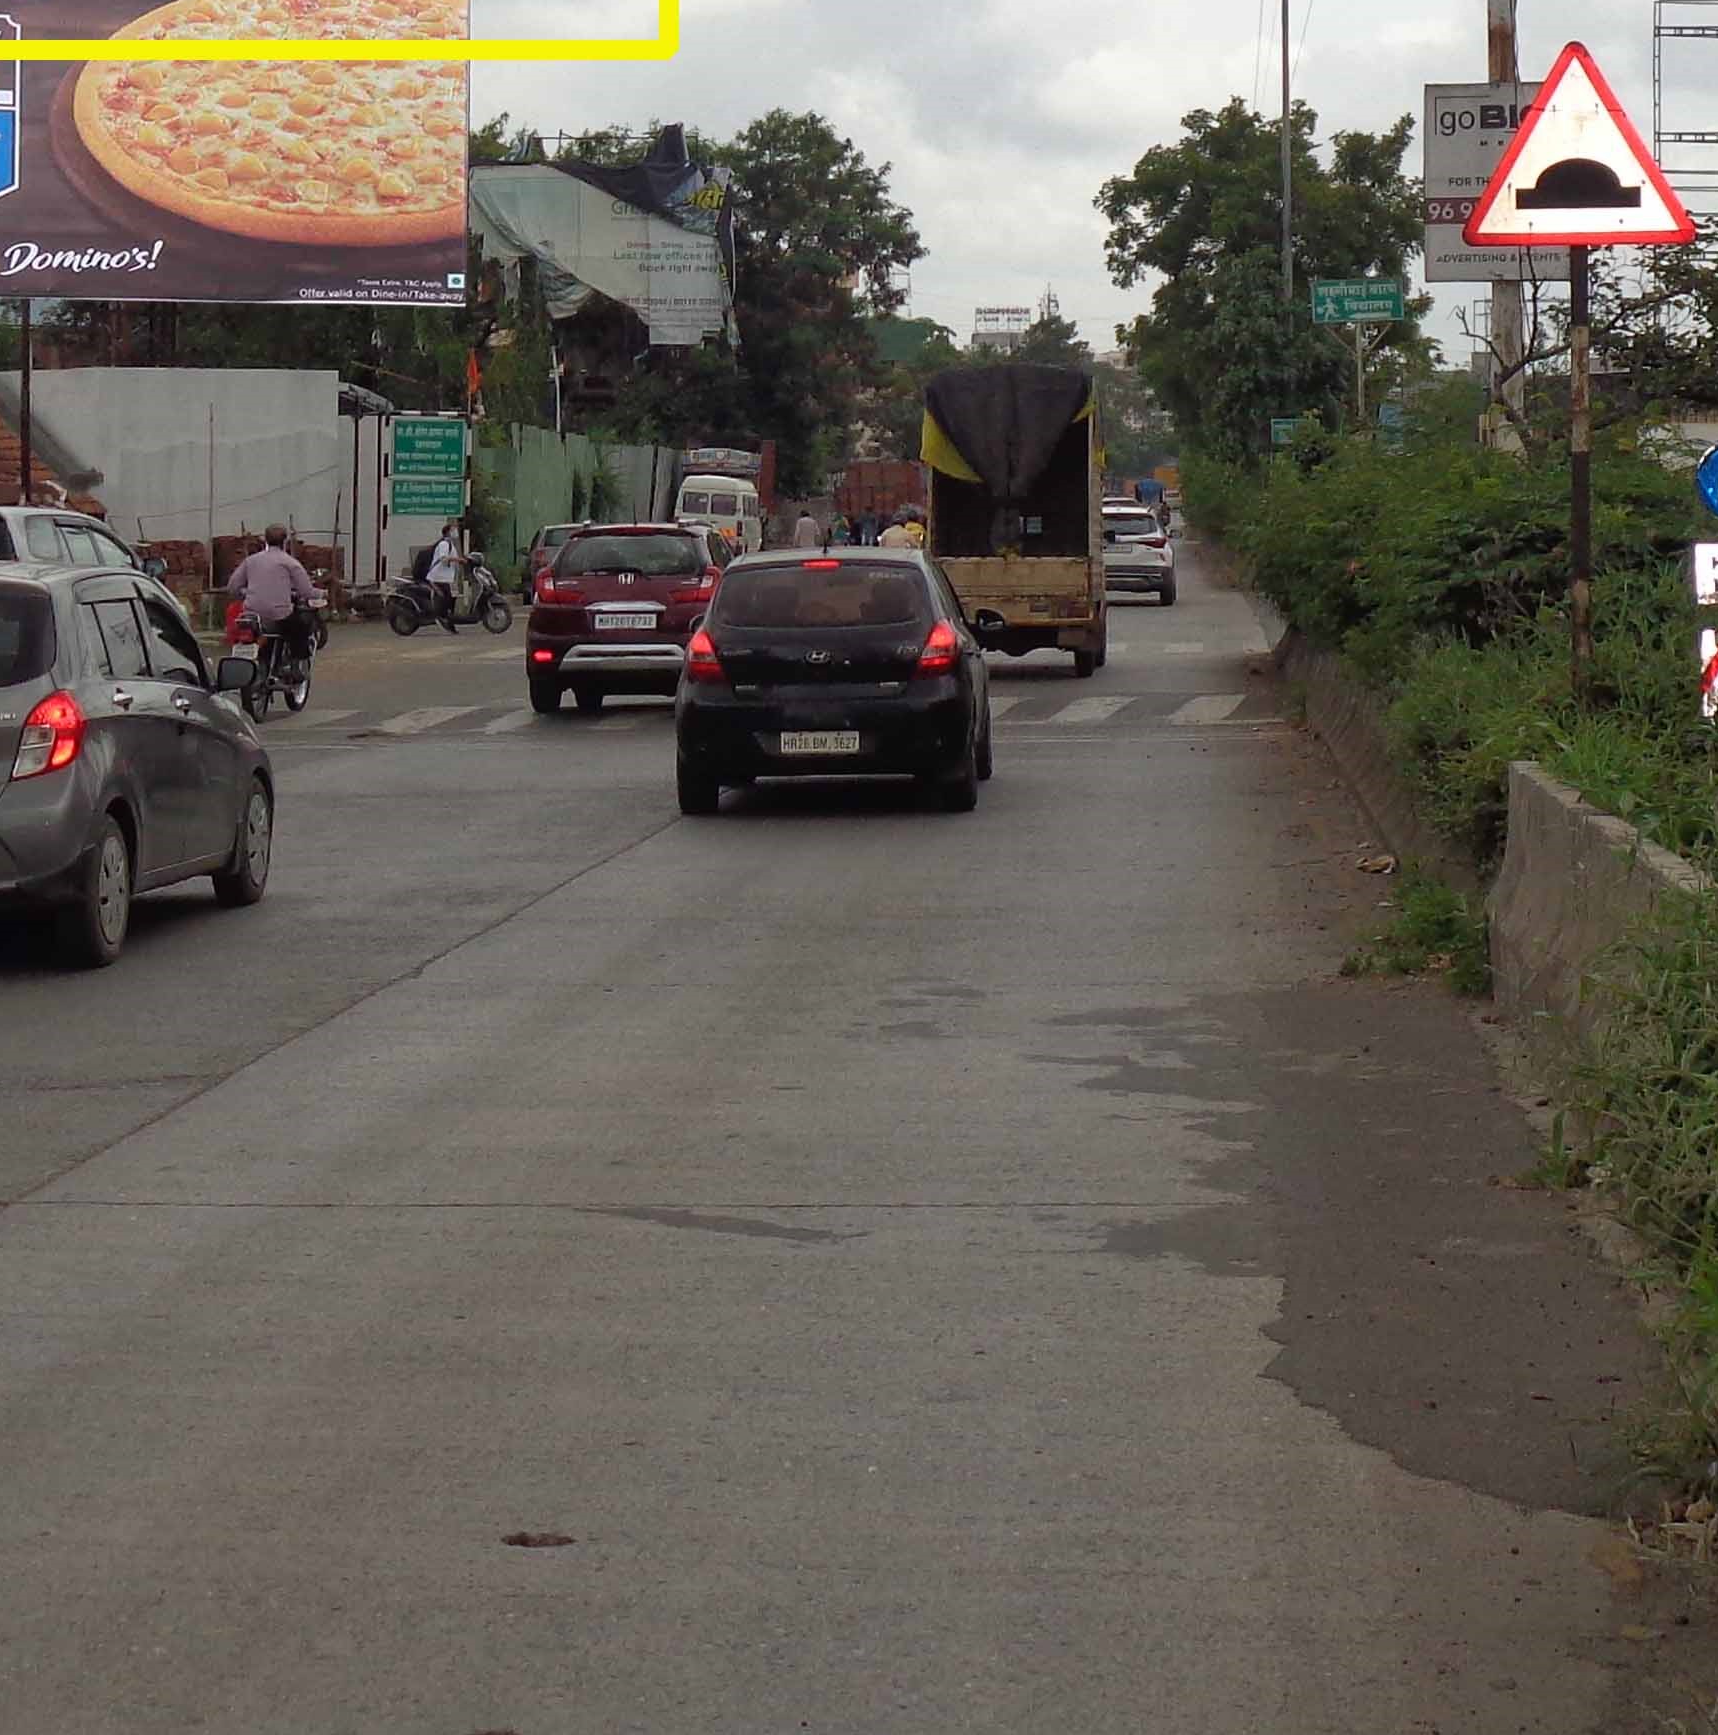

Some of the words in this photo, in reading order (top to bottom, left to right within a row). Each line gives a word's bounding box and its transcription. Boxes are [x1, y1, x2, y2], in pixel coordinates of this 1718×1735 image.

[1449, 177, 1471, 187] FOR
[1428, 202, 1454, 220] 96
[0, 239, 164, 276] Domino's!
[328, 290, 352, 299] valid
